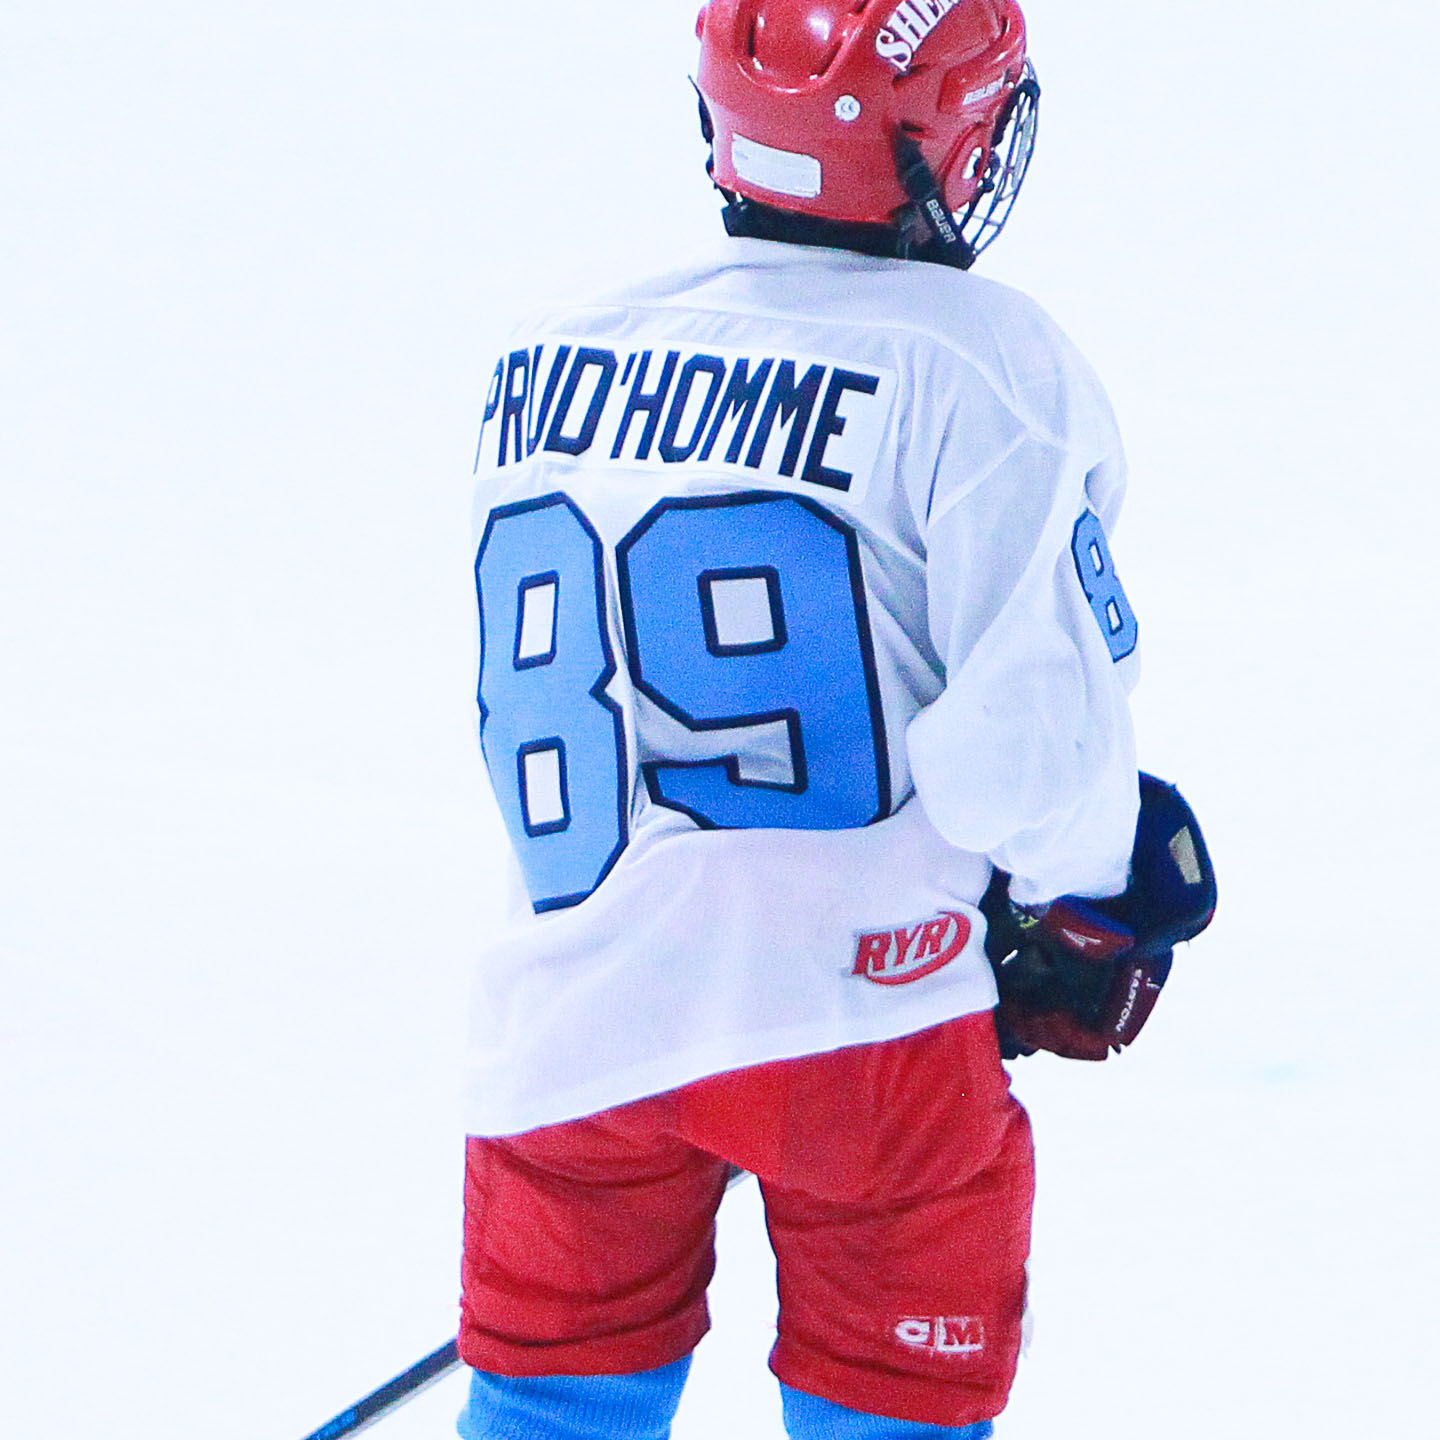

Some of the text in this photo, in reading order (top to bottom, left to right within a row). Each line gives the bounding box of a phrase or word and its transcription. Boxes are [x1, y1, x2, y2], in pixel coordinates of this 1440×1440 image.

[926, 198, 957, 243] BAUER
[473, 343, 880, 493] PRUD'HOMME
[474, 490, 894, 915] 89
[851, 916, 954, 976] RYR
[1114, 968, 1143, 1033] EASTON
